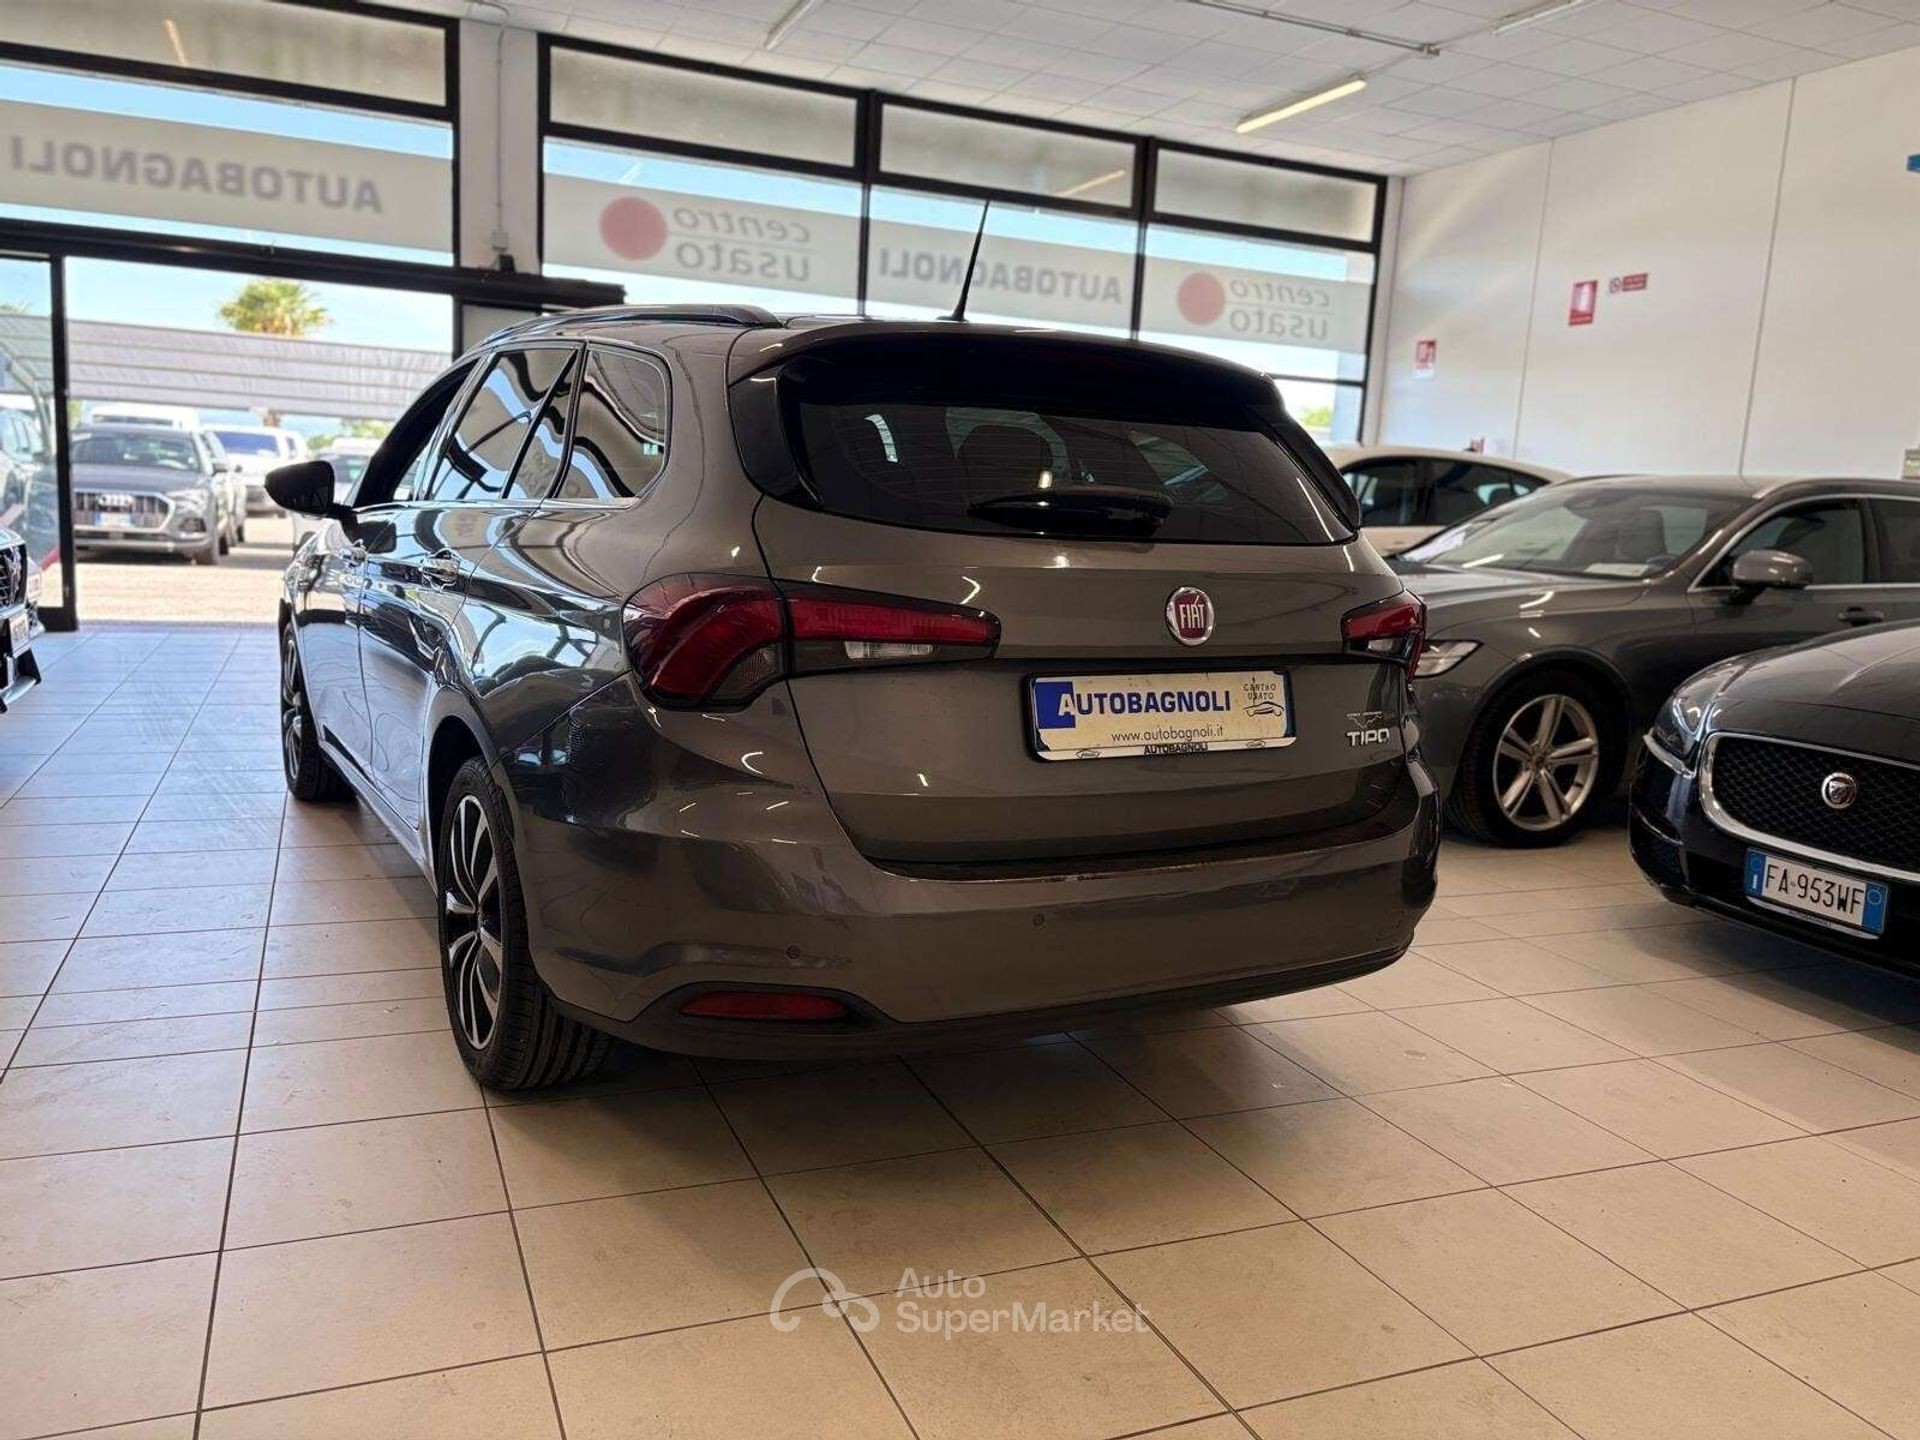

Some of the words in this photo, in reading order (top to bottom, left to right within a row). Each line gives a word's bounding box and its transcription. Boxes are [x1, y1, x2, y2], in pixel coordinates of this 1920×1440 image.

[1179, 601, 1205, 629] FIAT
[1058, 690, 1231, 716] AUTOBAGNOLI
[1111, 724, 1224, 744] www.autobagnoli.it
[1346, 728, 1390, 746] TIPO
[1144, 742, 1208, 756] AUTOBAGNOLI
